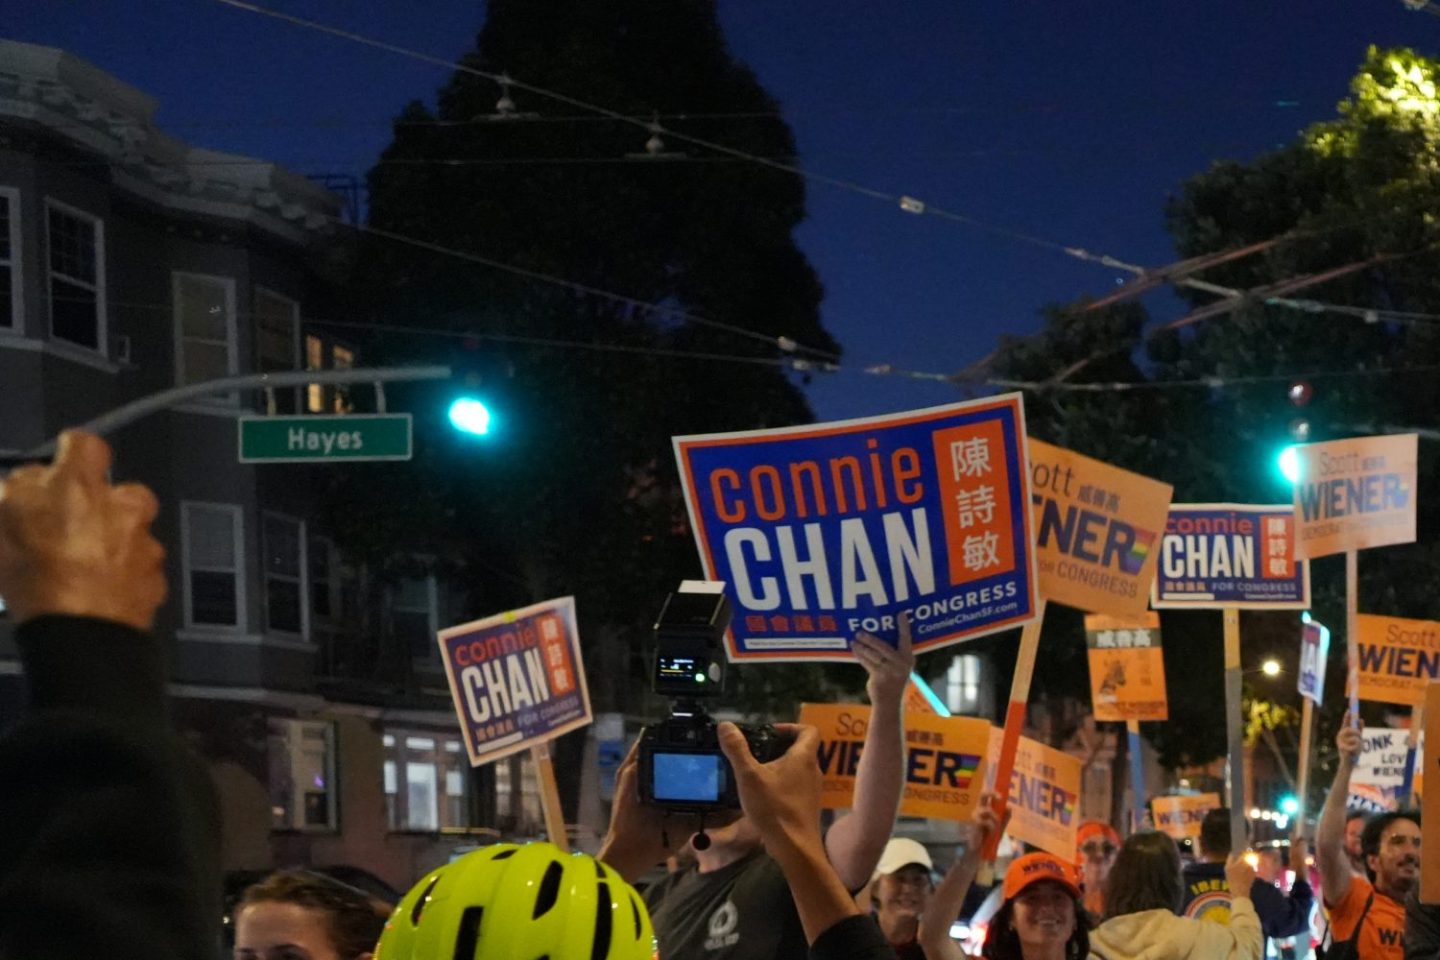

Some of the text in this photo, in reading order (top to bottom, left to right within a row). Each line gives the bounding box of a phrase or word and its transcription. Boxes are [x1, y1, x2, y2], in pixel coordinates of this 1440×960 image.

[288, 427, 363, 455] Hayes
[709, 438, 924, 523] connie
[1029, 462, 1074, 497] ott
[1320, 451, 1360, 477] Scott
[950, 436, 1001, 572] 陳詩敏
[1300, 473, 1403, 523] WIENER
[1164, 512, 1253, 534] connie
[724, 507, 935, 611] CHAN
[1163, 534, 1254, 579] CHAN
[1057, 560, 1139, 599] CONGRESS
[1212, 582, 1234, 592] FOR
[1237, 581, 1297, 592] CONGRESS
[848, 616, 895, 632] FOR
[918, 600, 1018, 634] ConnieChanSF.com
[455, 622, 538, 666] connie
[1387, 624, 1437, 648] Scott
[461, 647, 550, 723] CHAN
[1362, 734, 1394, 753] ONK
[1381, 754, 1405, 765] LOV
[903, 787, 970, 806] ONGRESS
[1007, 769, 1069, 825] ENER
